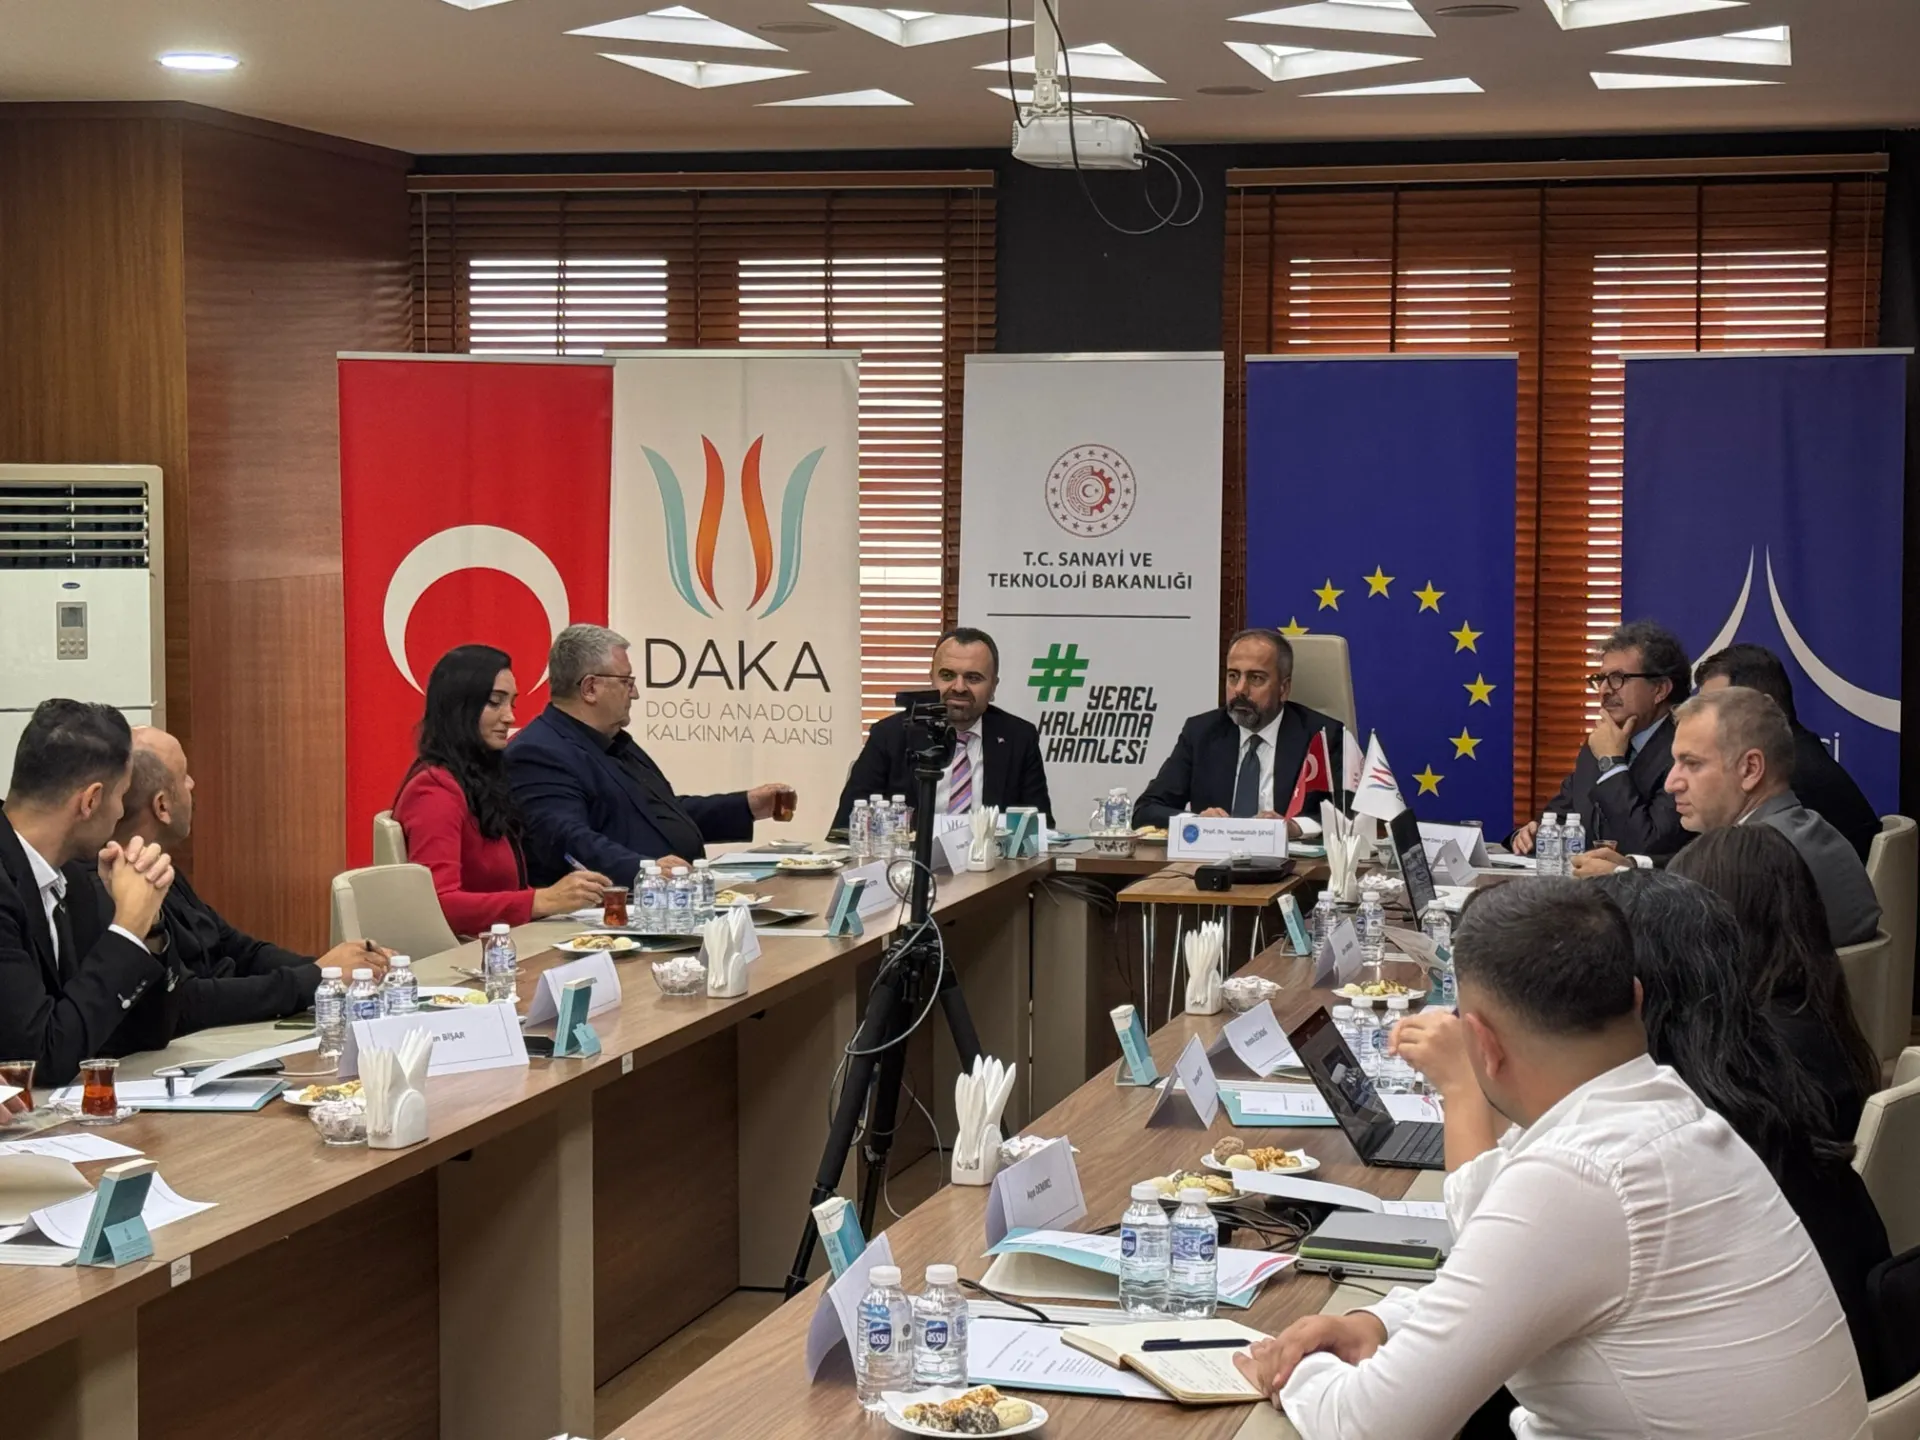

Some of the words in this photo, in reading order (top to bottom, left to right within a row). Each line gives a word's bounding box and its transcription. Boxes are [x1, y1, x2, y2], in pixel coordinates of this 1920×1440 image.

[1023, 551, 1053, 567] T.C.
[1058, 548, 1124, 567] SANAYİ
[1130, 552, 1152, 567] VE
[988, 571, 1086, 588] TEKNOLOJİ
[1092, 571, 1192, 590] BAKANLIĞI
[645, 637, 831, 693] DAKA
[646, 698, 711, 719] DOĞU
[720, 703, 832, 723] ANADOLU
[646, 724, 754, 743] KALKINMA
[763, 727, 832, 745] AJANSI
[1039, 711, 1154, 738] KALKINMA
[1045, 738, 1148, 765] HAMLESİ
